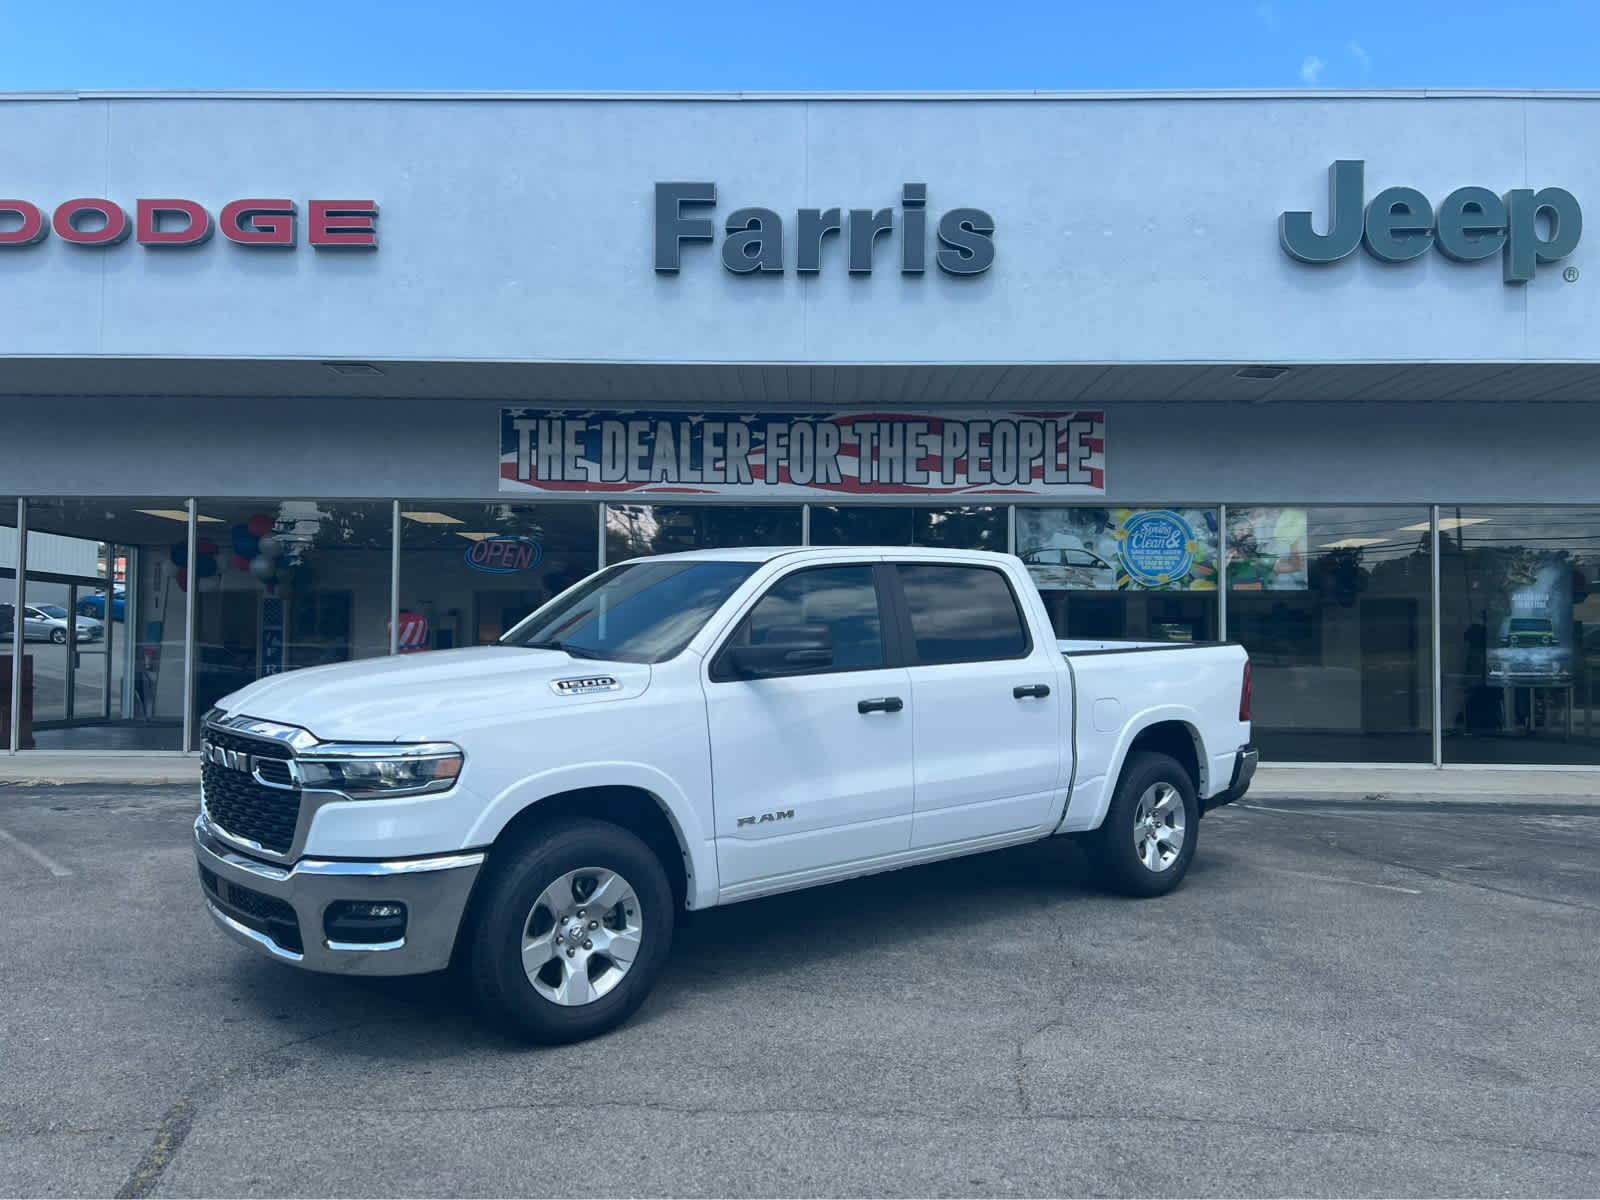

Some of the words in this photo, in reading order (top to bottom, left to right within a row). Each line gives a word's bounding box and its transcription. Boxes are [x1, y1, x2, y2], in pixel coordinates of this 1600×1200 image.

[0, 198, 378, 250] DODGE
[654, 181, 995, 276] Farris
[1279, 159, 1582, 284] Jeep
[514, 418, 589, 482] THE
[600, 420, 753, 485] DEALER
[764, 419, 844, 486] FOR
[851, 419, 931, 485] THE
[940, 419, 1095, 486] PEOPLE
[471, 541, 533, 569] OPEN
[562, 678, 612, 689] 1500
[201, 742, 248, 773] RAM
[737, 809, 794, 828] RAM
